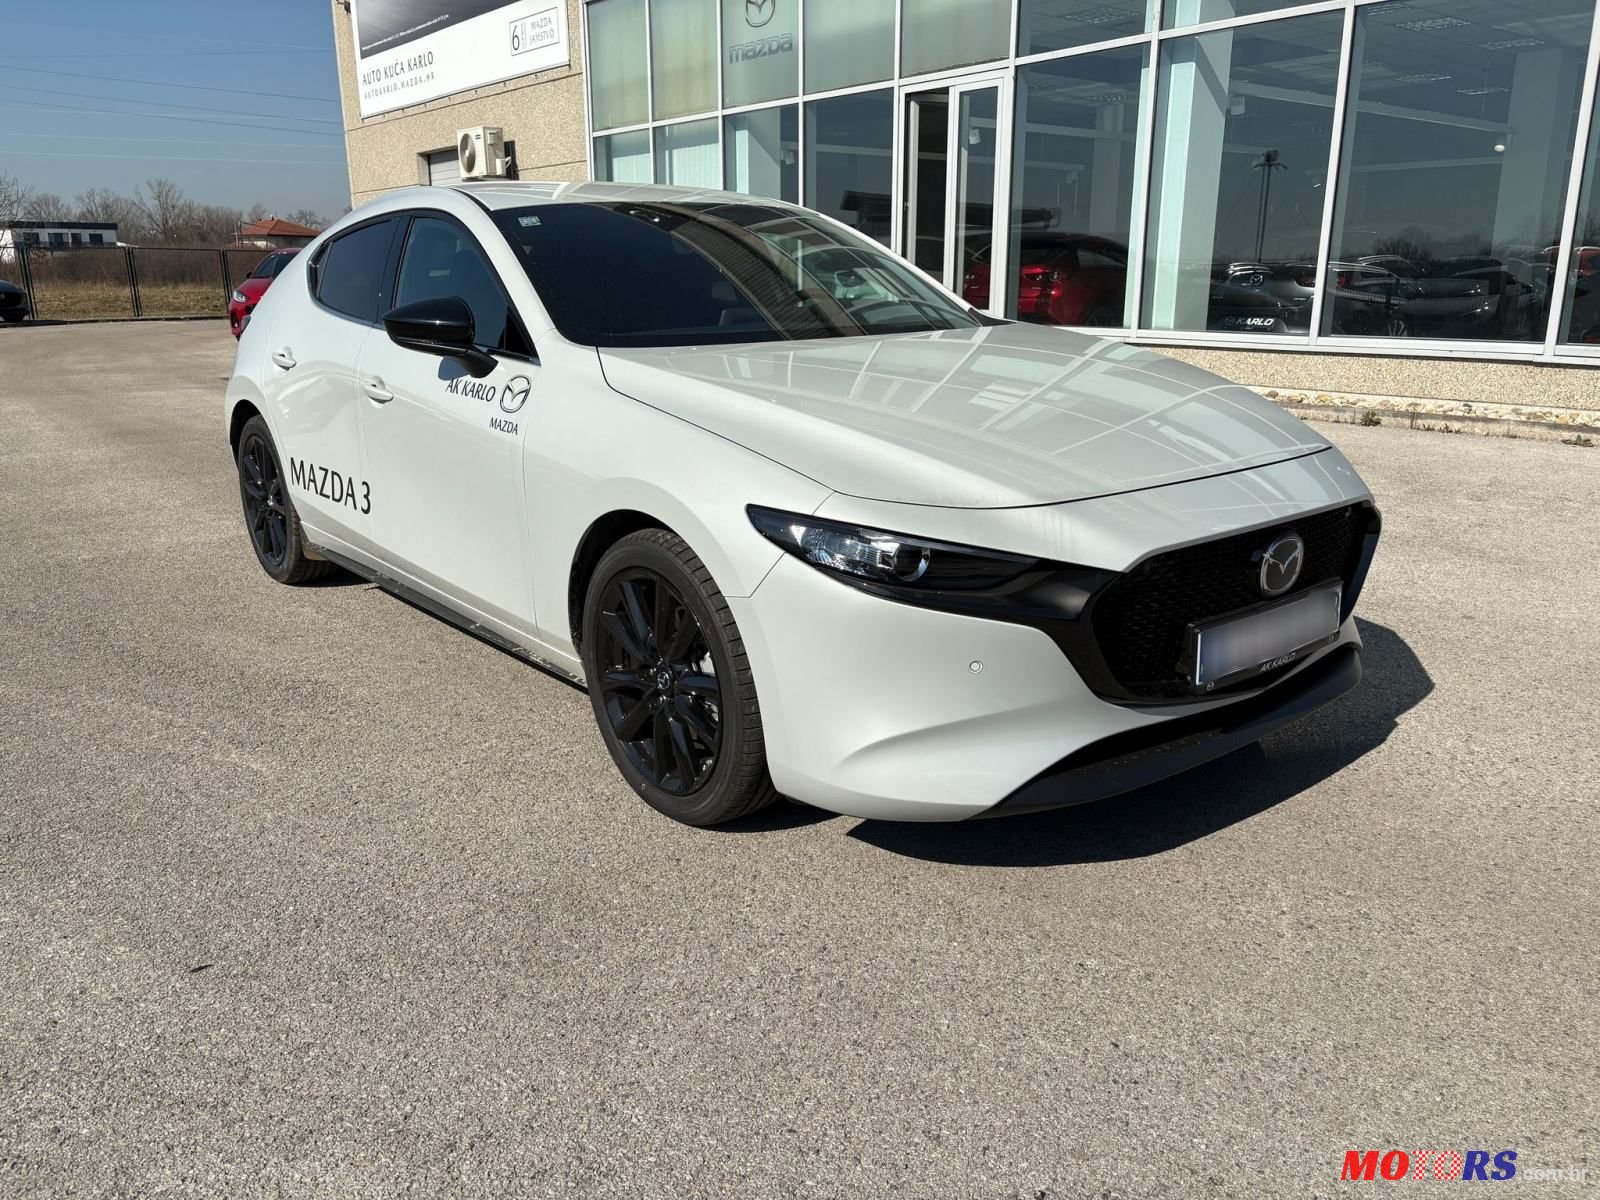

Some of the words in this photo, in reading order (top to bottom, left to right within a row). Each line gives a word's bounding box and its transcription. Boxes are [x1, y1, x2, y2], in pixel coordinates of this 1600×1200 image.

[530, 16, 553, 30] MAZDA
[512, 24, 520, 51] 6
[362, 68, 382, 86] AUTO
[383, 59, 405, 79] KUĆA
[407, 51, 434, 72] KARLO
[1236, 317, 1274, 326] KARLO
[445, 378, 462, 395] AK
[461, 380, 496, 402] KARLO
[489, 417, 518, 435] MAZDA
[290, 456, 357, 510] MAZDA
[360, 480, 371, 515] 3
